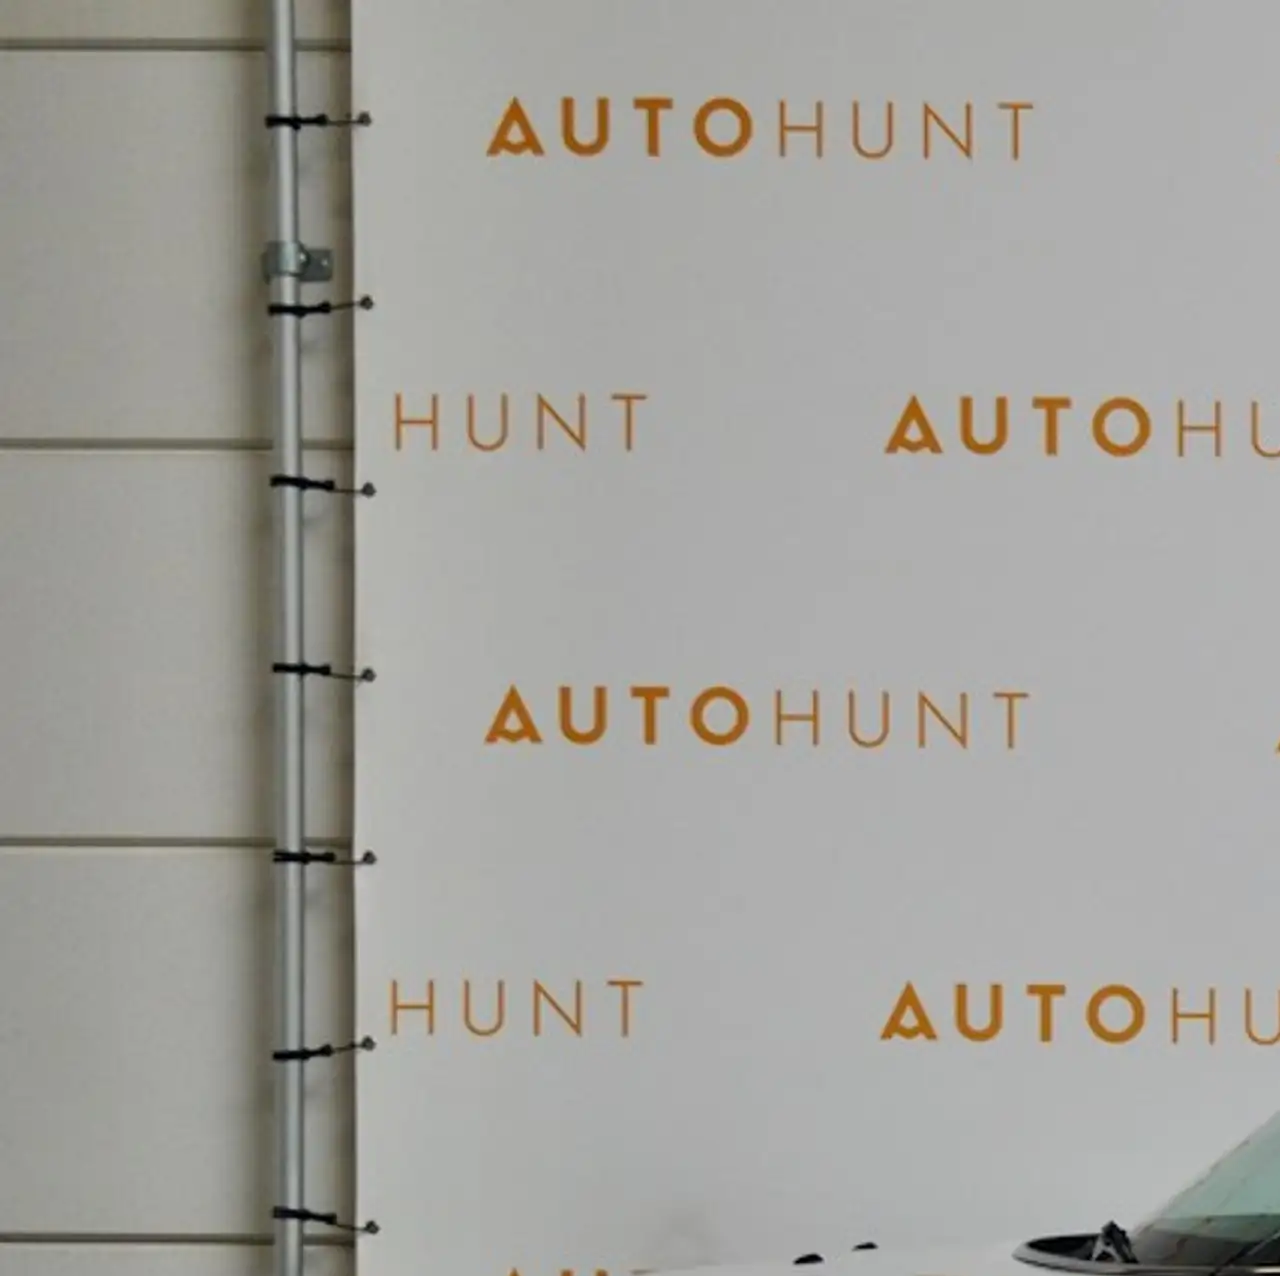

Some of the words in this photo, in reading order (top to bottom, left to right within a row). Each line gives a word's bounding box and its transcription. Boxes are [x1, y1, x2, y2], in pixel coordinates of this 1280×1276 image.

[485, 94, 1033, 161] AUTOHUNT
[393, 391, 647, 452] HUNT
[484, 683, 1027, 749] AUTOHUNT
[389, 977, 643, 1038] HUNT
